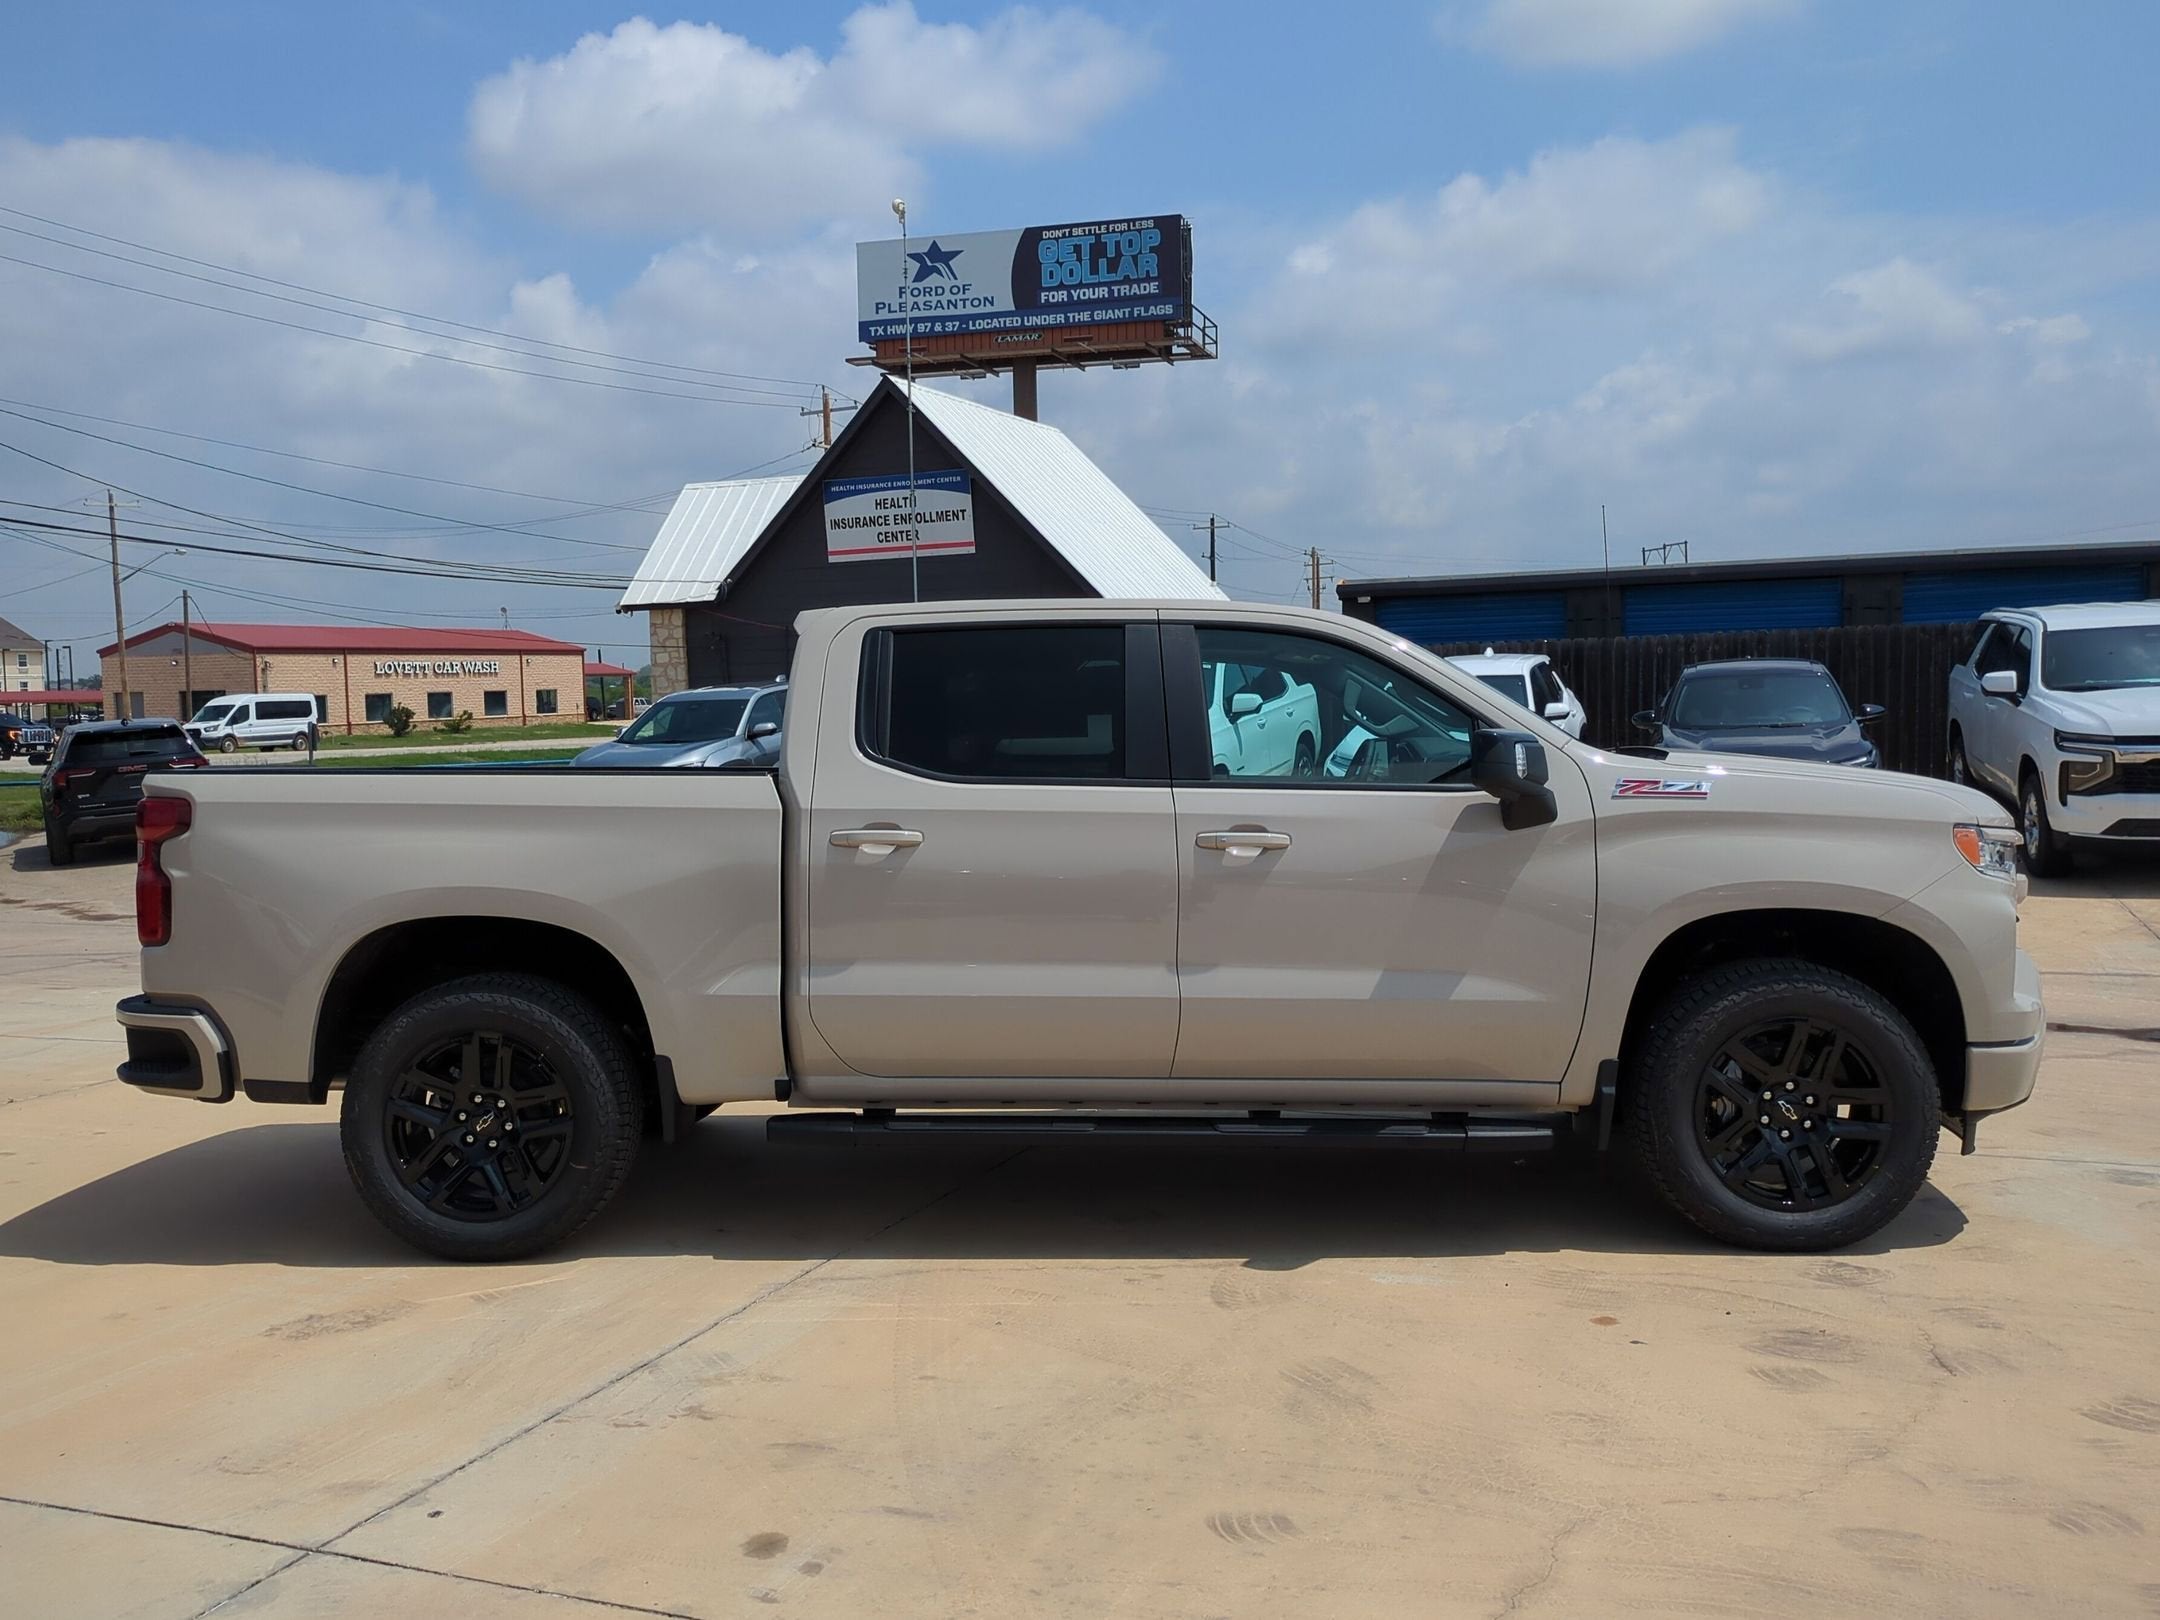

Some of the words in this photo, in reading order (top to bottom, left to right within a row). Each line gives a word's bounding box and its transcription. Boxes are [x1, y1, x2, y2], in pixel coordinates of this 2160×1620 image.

[1042, 228, 1071, 239] DON'T
[1072, 224, 1107, 236] SETTLE
[1109, 221, 1128, 232] FOR
[1130, 219, 1154, 230] LESS
[1038, 235, 1095, 264] GET
[1101, 228, 1161, 258] TOP
[1041, 253, 1158, 287] DOLLAR
[898, 285, 945, 299] FORD
[949, 283, 973, 296] OF
[1040, 290, 1068, 304] FOR
[1070, 287, 1109, 300] YOUR
[1111, 282, 1159, 298] TRADE
[875, 296, 995, 315] PLEASANTON
[869, 326, 885, 337] TX
[887, 323, 915, 335] HWY
[917, 322, 932, 333] 97
[934, 322, 943, 332] &
[945, 321, 960, 332] 37
[969, 316, 1021, 330] LOCATED
[1024, 313, 1065, 326] UNDER
[1067, 311, 1091, 323] THE
[1093, 308, 1131, 320] GIANT
[1133, 304, 1173, 317] FLAGS
[997, 334, 1039, 343] LAMAR
[856, 481, 892, 490] INSURANCE
[893, 478, 935, 487] ENROLMENT
[937, 475, 962, 484] CENTER
[875, 495, 917, 510] HEALTH
[830, 514, 891, 530] INSURANCE
[375, 661, 432, 674] LOVETT
[434, 661, 461, 674] CAR
[462, 661, 500, 673] WASH
[117, 764, 148, 773] GMC
[1614, 778, 1712, 798] Z71
